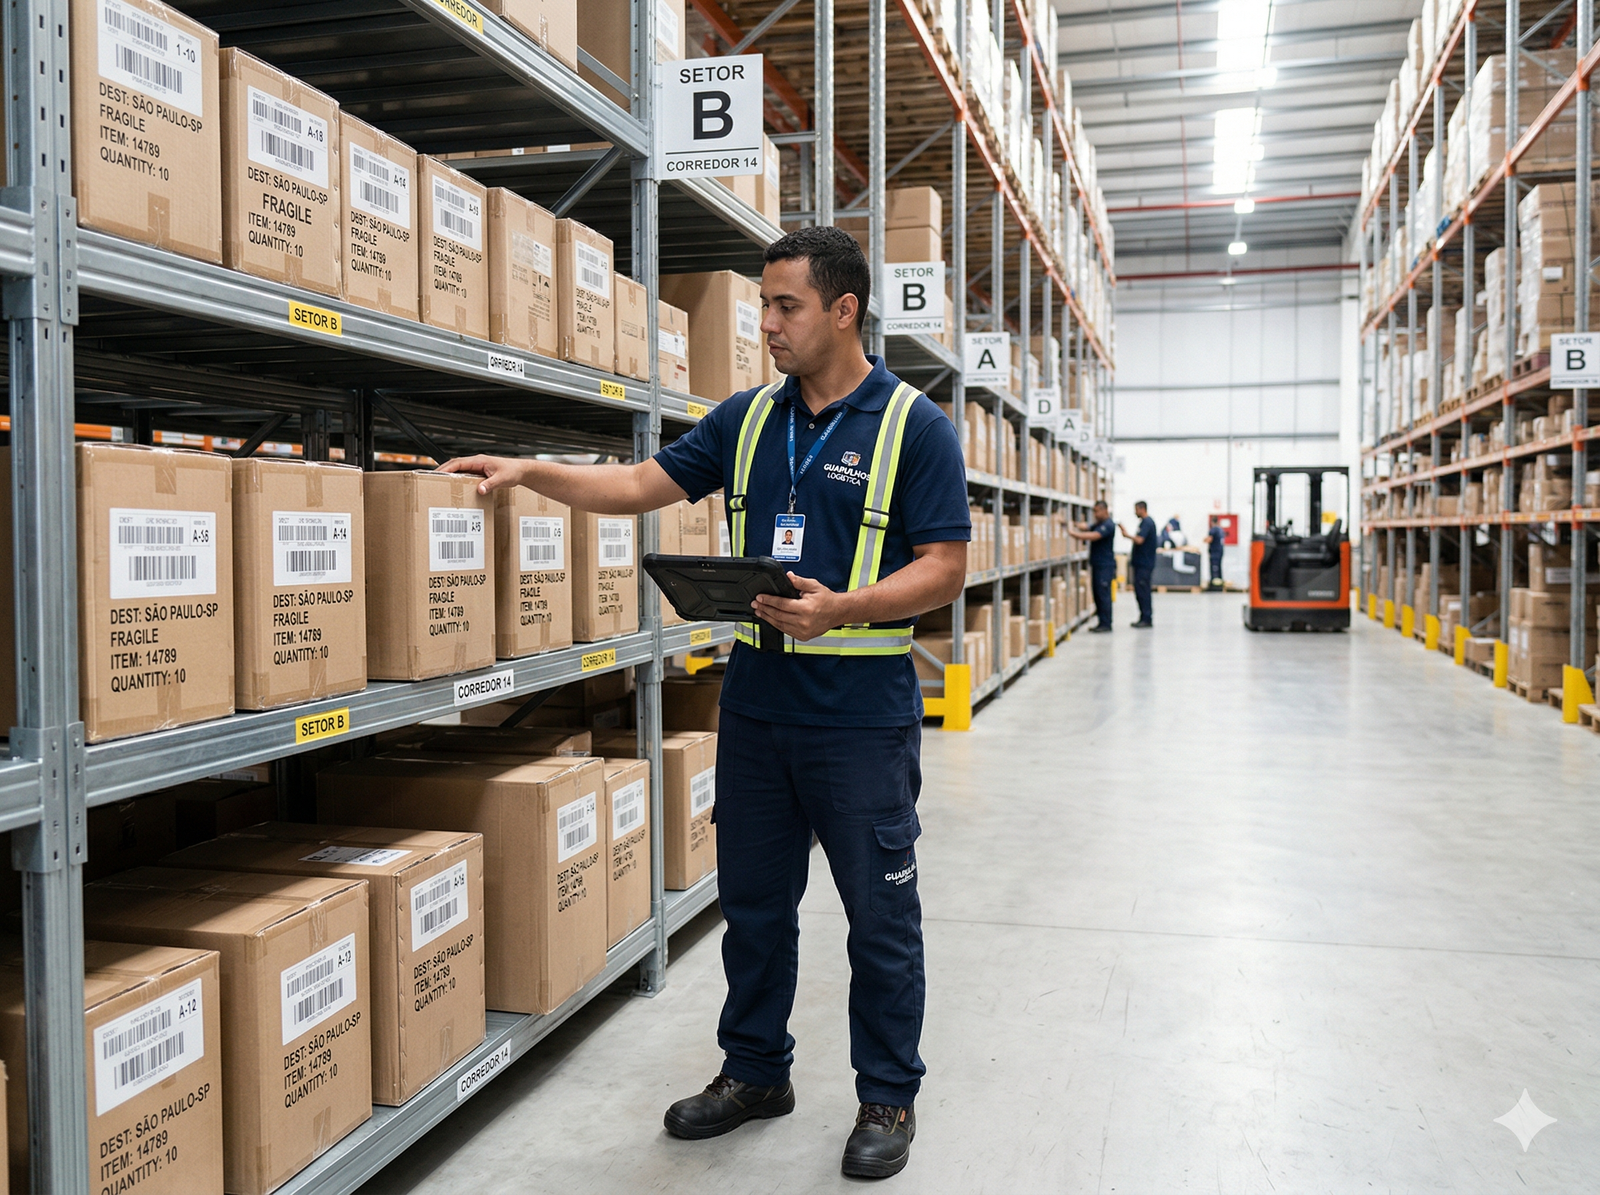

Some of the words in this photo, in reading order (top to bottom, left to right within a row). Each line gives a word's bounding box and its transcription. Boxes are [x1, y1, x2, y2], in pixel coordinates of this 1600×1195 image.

[679, 64, 745, 84] SETOR
[99, 82, 130, 106] DEST:
[132, 94, 154, 115] SÃO
[156, 104, 203, 133] PAULO-SP
[99, 103, 145, 132] FRAGILE
[693, 90, 734, 140] B
[100, 125, 129, 148] ITEM:
[132, 136, 160, 158] 14789
[99, 146, 156, 177] QUANTITY:
[158, 166, 170, 181] 10
[666, 157, 740, 172] CORREDOR
[743, 156, 758, 168] 14
[247, 166, 272, 187] DEST:
[273, 174, 291, 193] SÃO
[291, 180, 328, 206] PAULO-SP
[262, 192, 312, 225] FRAGILE
[248, 211, 271, 231] ITEM:
[273, 219, 296, 238] 14789
[248, 229, 293, 254] QUANTITY:
[294, 244, 304, 258] 10
[350, 258, 384, 279] QUANTITY:
[384, 269, 392, 282] 10
[894, 267, 934, 278] SETOR
[902, 283, 926, 311] B
[294, 308, 329, 329] SETOR
[330, 317, 338, 330] B
[886, 322, 929, 331] CORREDOR
[977, 348, 997, 370] A
[1566, 349, 1586, 370] B
[1038, 399, 1051, 414] D
[1063, 417, 1075, 430] A
[273, 593, 297, 609] DEST:
[298, 589, 316, 607] SÃO
[316, 589, 354, 605] PAULO-SP
[110, 607, 142, 625] DEST:
[144, 603, 168, 622] SÃO
[170, 602, 219, 620] PAULO-SP
[273, 610, 309, 628] FRAGILE
[110, 628, 159, 648] FRAGILE
[273, 631, 297, 647] ITEM:
[298, 627, 322, 643] 14789
[429, 621, 461, 637] QUANTITY:
[110, 651, 142, 670] ITEM:
[145, 648, 177, 666] 14789
[273, 647, 318, 666] QUANTITY:
[319, 645, 329, 660] 10
[110, 670, 171, 693] QUANTITY:
[174, 668, 186, 684] 10
[458, 677, 502, 699] CORREDOR
[503, 675, 512, 688] 14
[301, 716, 336, 737] SETOR
[337, 714, 345, 729] B
[413, 959, 432, 980] DEST:
[432, 950, 446, 968] SÃO
[414, 976, 432, 996] ITEM:
[414, 982, 448, 1012] QUANTITY:
[448, 976, 456, 991] 10
[178, 998, 197, 1020] A-12
[283, 1045, 307, 1071] DEST:
[308, 1034, 326, 1056] SÃO
[326, 1011, 361, 1044] PAULO-SP
[284, 1065, 307, 1090] ITEM:
[308, 1047, 332, 1071] 14789
[460, 1053, 501, 1093] CORREDOR
[500, 1046, 509, 1061] 14
[284, 1070, 328, 1109] QUANTITY:
[329, 1062, 338, 1078] 10
[100, 1127, 133, 1159] DEST:
[135, 1113, 159, 1139] SÃO
[160, 1082, 211, 1125] PAULO-SP
[100, 1150, 134, 1182] ITEM:
[136, 1129, 169, 1160] 14789
[165, 1145, 178, 1166] 10
